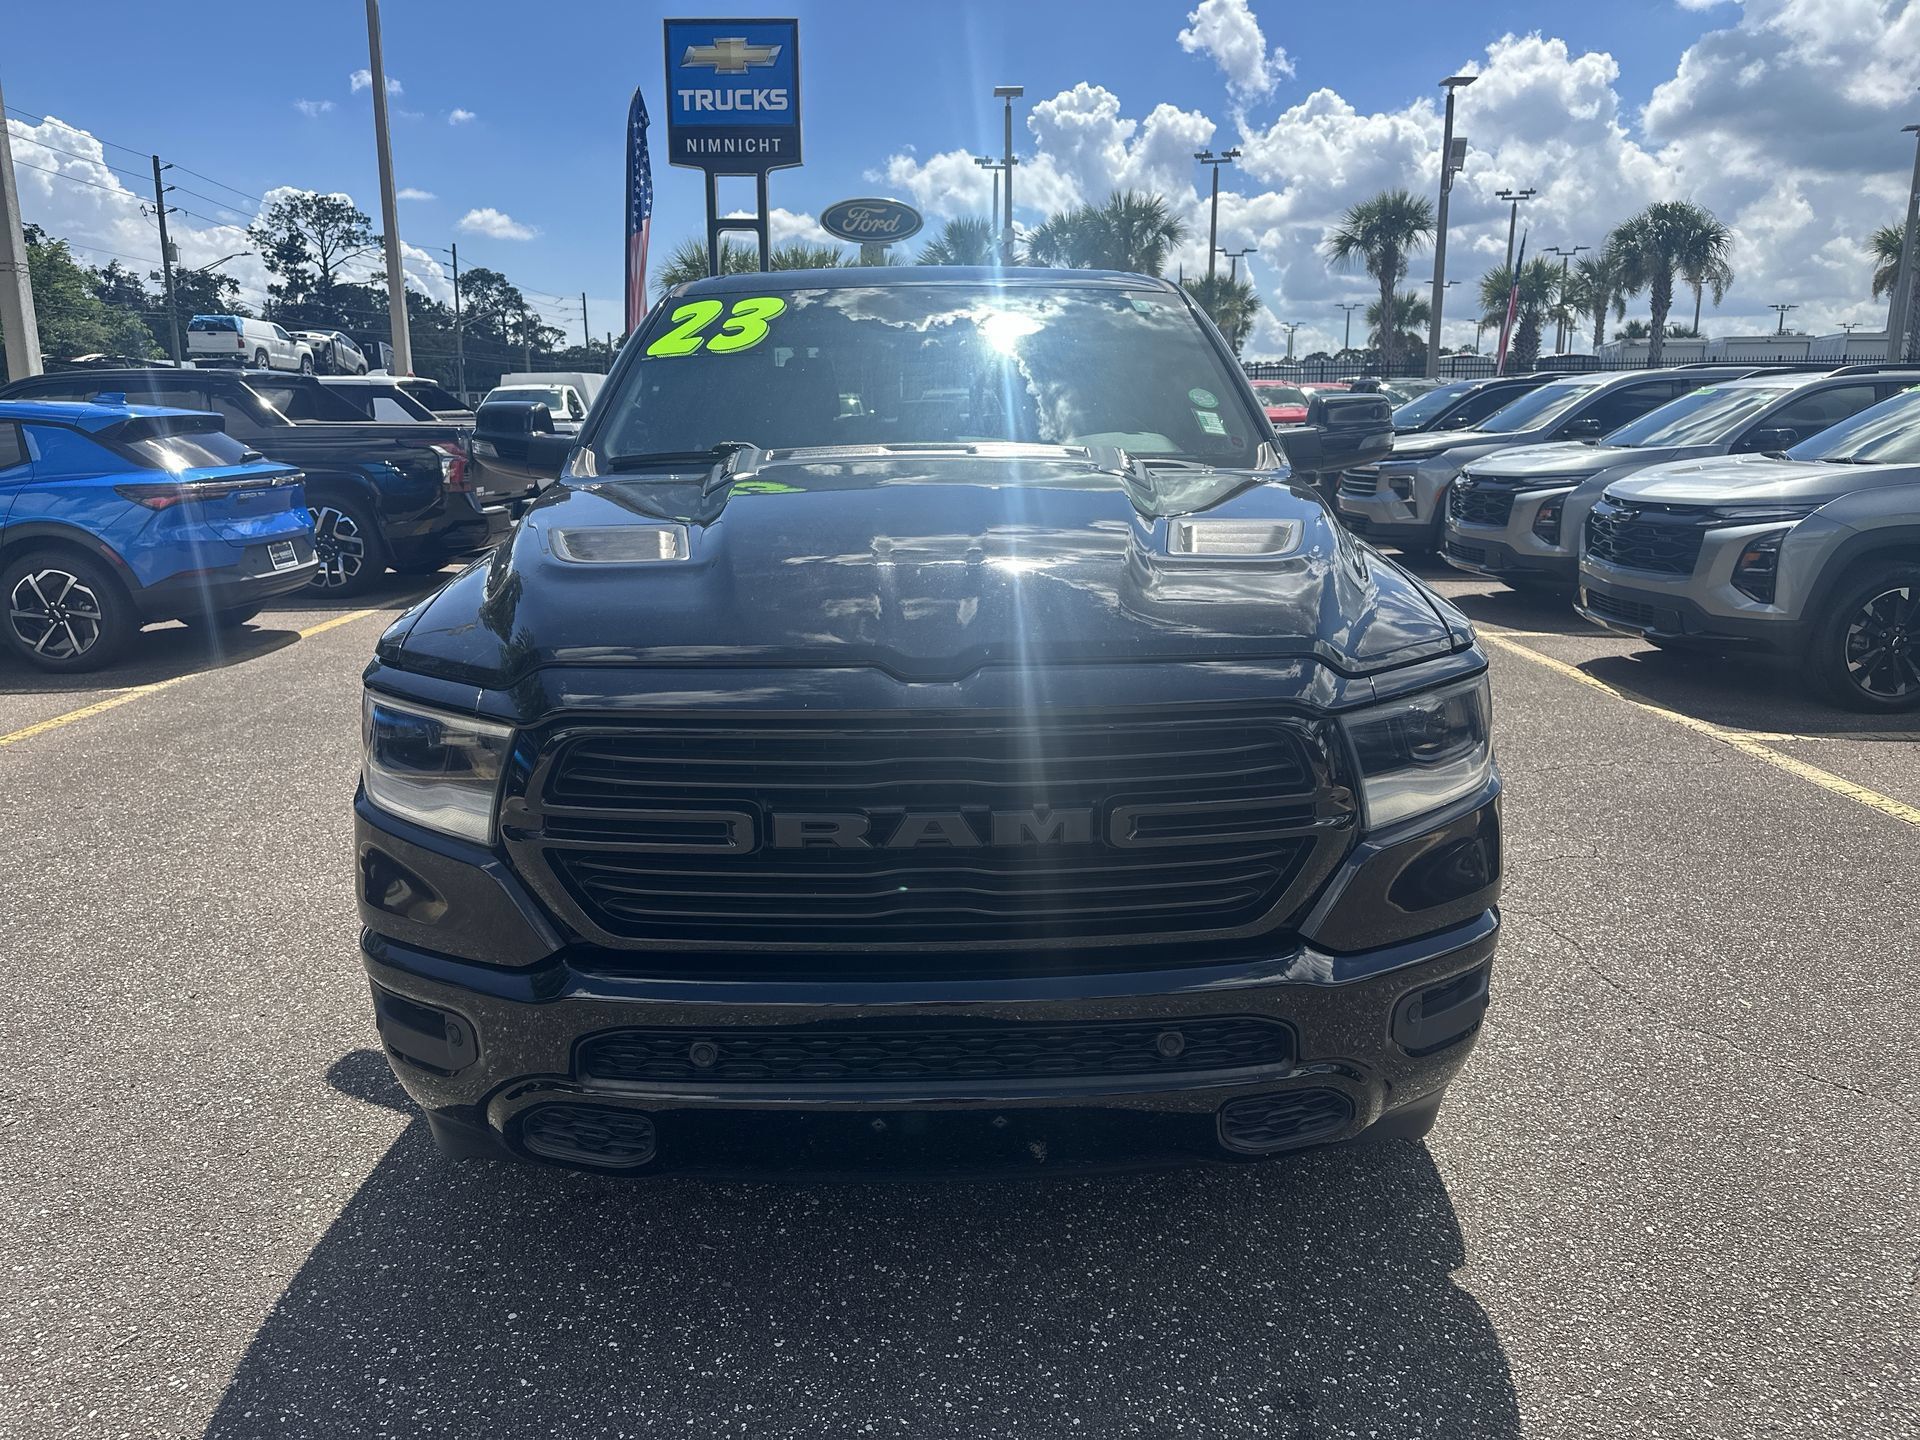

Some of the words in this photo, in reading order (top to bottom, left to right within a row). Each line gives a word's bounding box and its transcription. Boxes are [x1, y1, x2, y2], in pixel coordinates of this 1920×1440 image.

[677, 88, 788, 111] TRUCKS
[686, 138, 782, 153] NIMNICHT
[842, 206, 901, 233] Ford
[646, 297, 787, 358] 23
[772, 807, 1095, 849] RAM
